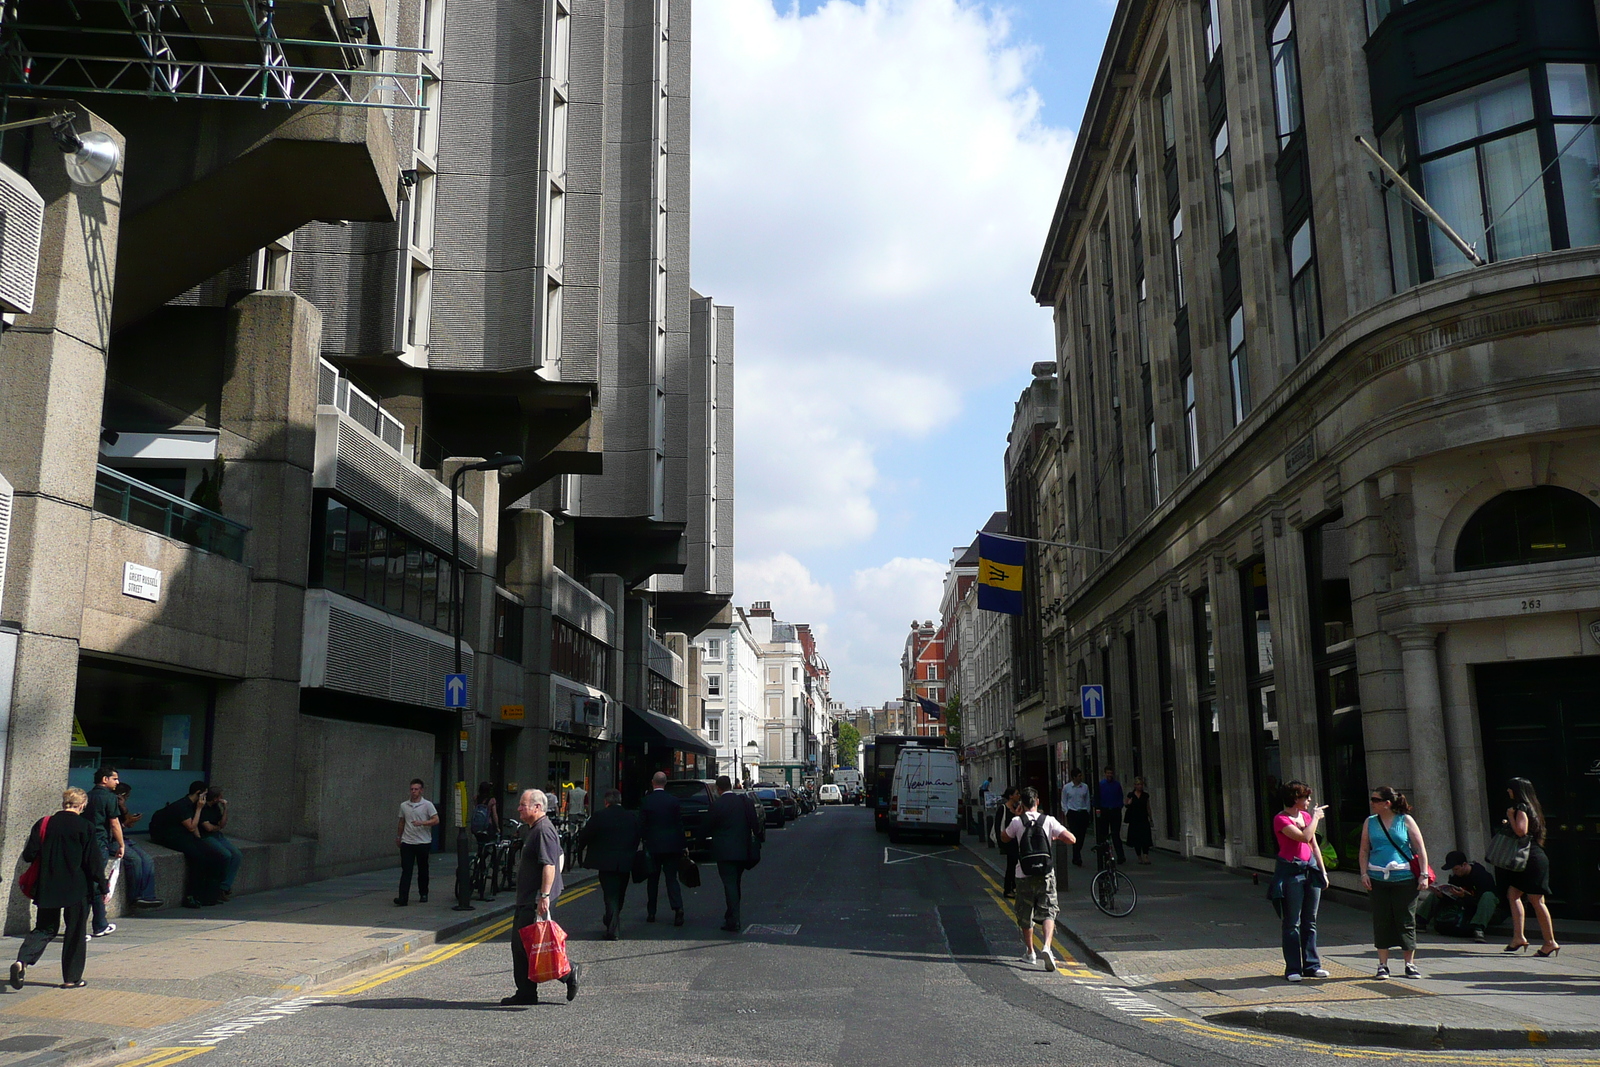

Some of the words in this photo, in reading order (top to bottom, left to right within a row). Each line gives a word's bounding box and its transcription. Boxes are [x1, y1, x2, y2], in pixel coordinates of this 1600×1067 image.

[129, 572, 142, 582] GREAT
[142, 575, 158, 587] RUSSELL
[128, 583, 142, 593] STREET
[1522, 600, 1541, 610] 263
[904, 761, 953, 793] Newman
